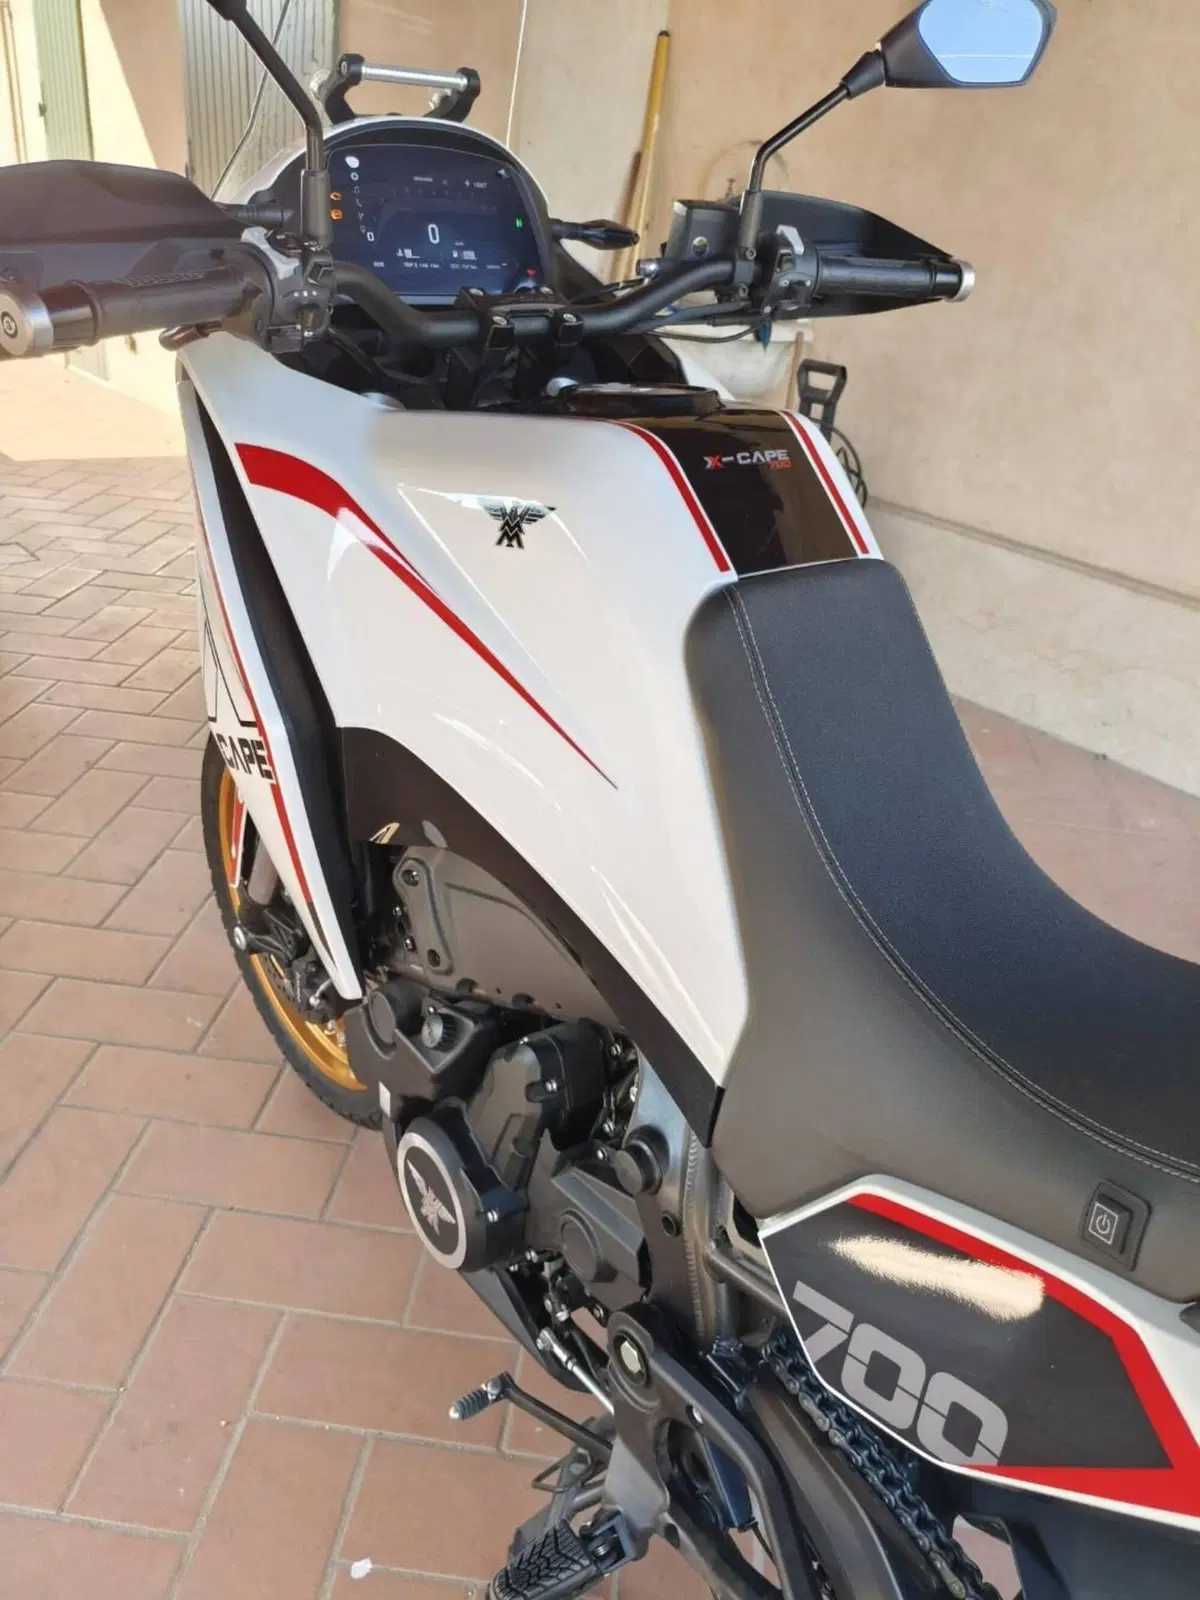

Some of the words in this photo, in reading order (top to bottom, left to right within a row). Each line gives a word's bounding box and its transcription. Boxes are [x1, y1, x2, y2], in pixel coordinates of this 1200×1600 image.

[366, 231, 375, 242] 0
[428, 223, 440, 244] 0
[216, 733, 274, 780] CAPE
[792, 1280, 1009, 1467] 700
